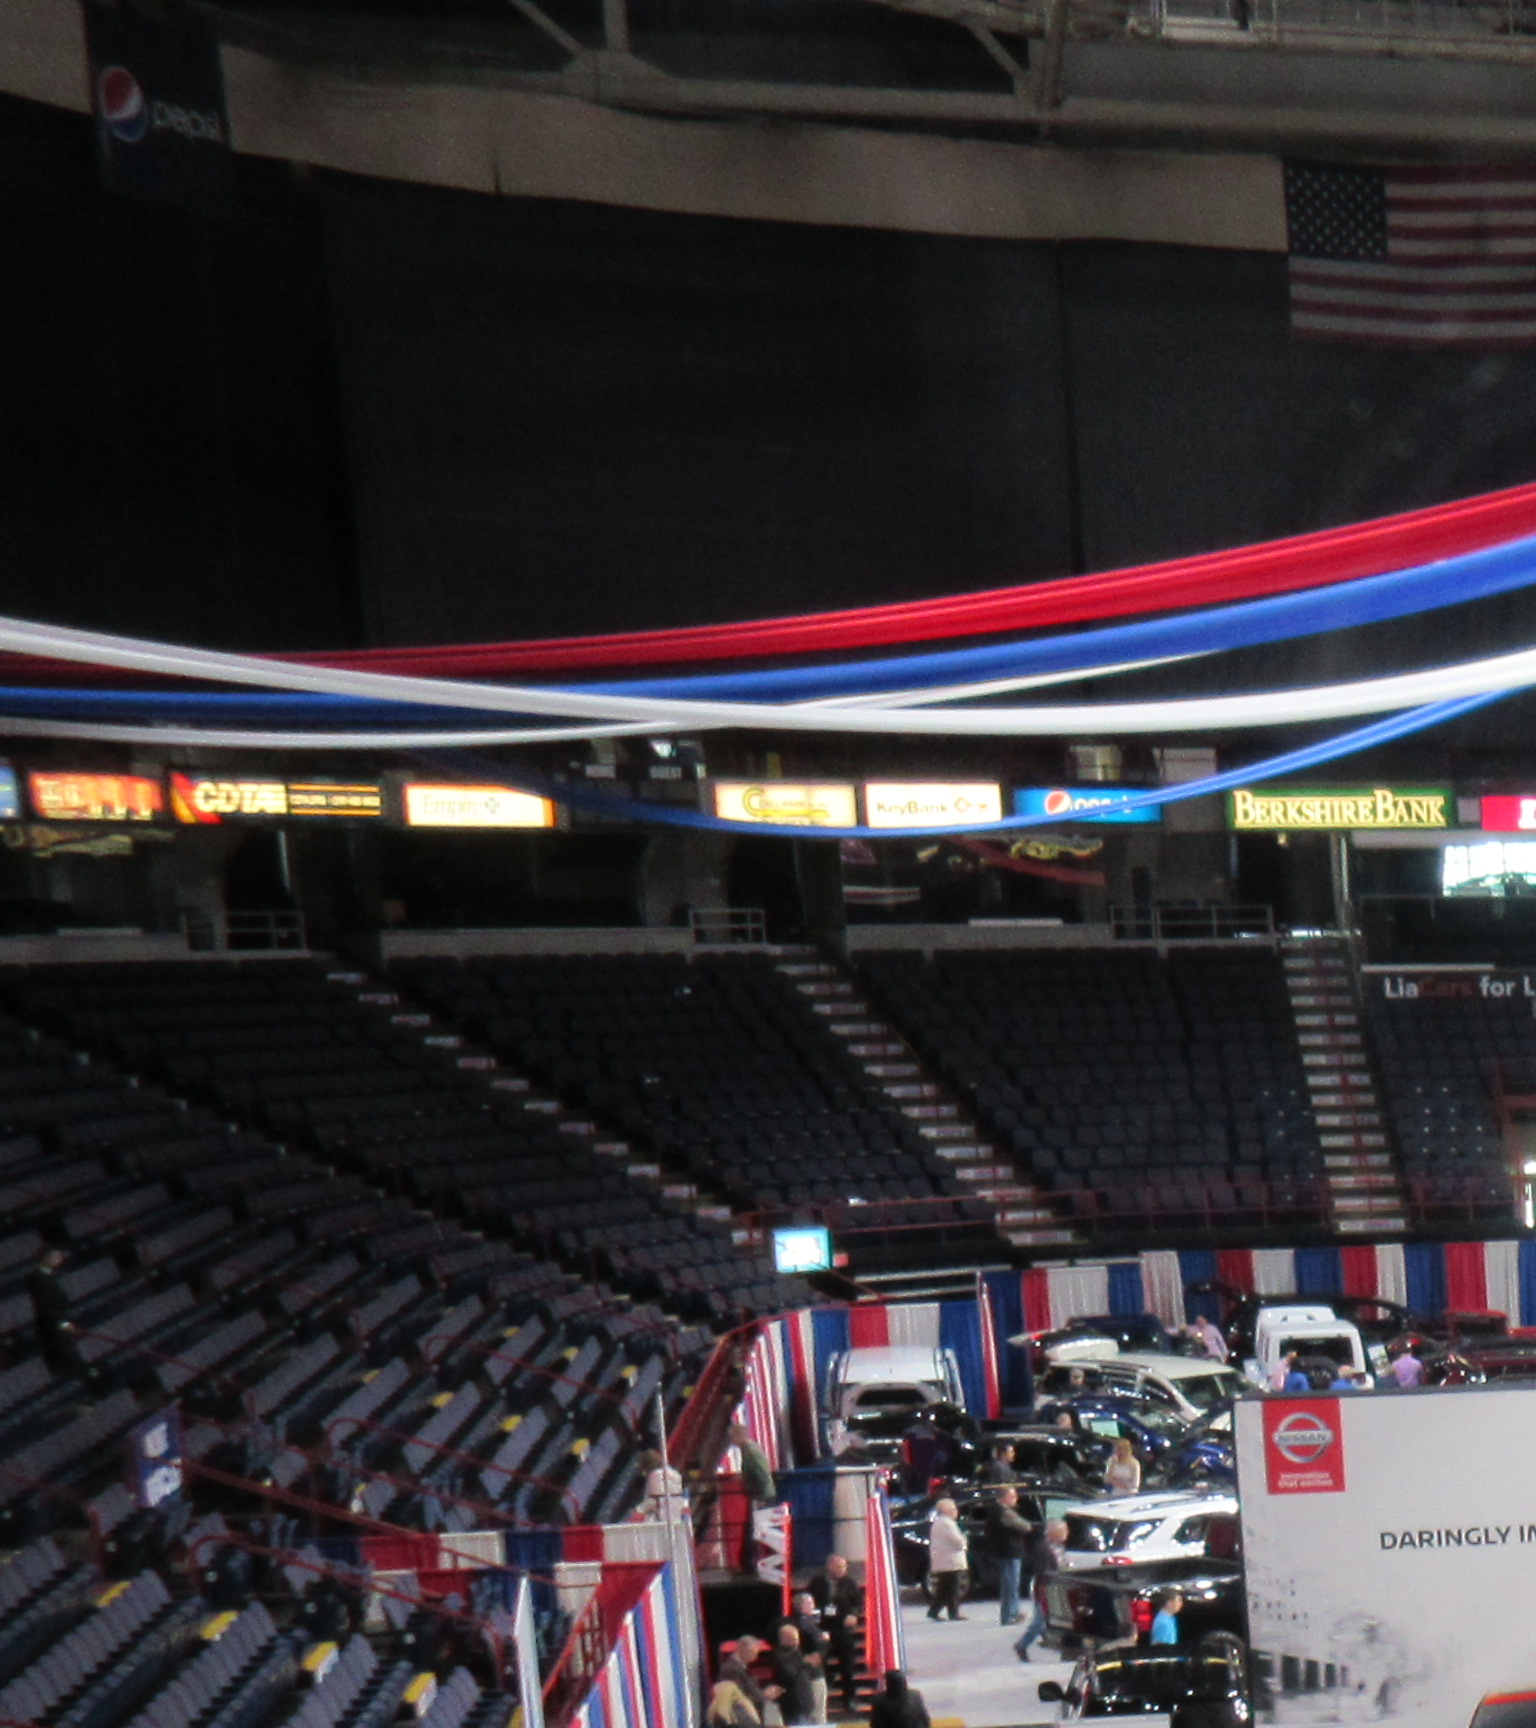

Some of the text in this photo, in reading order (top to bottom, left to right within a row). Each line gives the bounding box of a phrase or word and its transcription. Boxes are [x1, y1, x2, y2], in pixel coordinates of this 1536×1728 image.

[876, 801, 949, 816] KeyBank
[1480, 974, 1516, 998] for
[1379, 1525, 1512, 1550] DARINGLY
